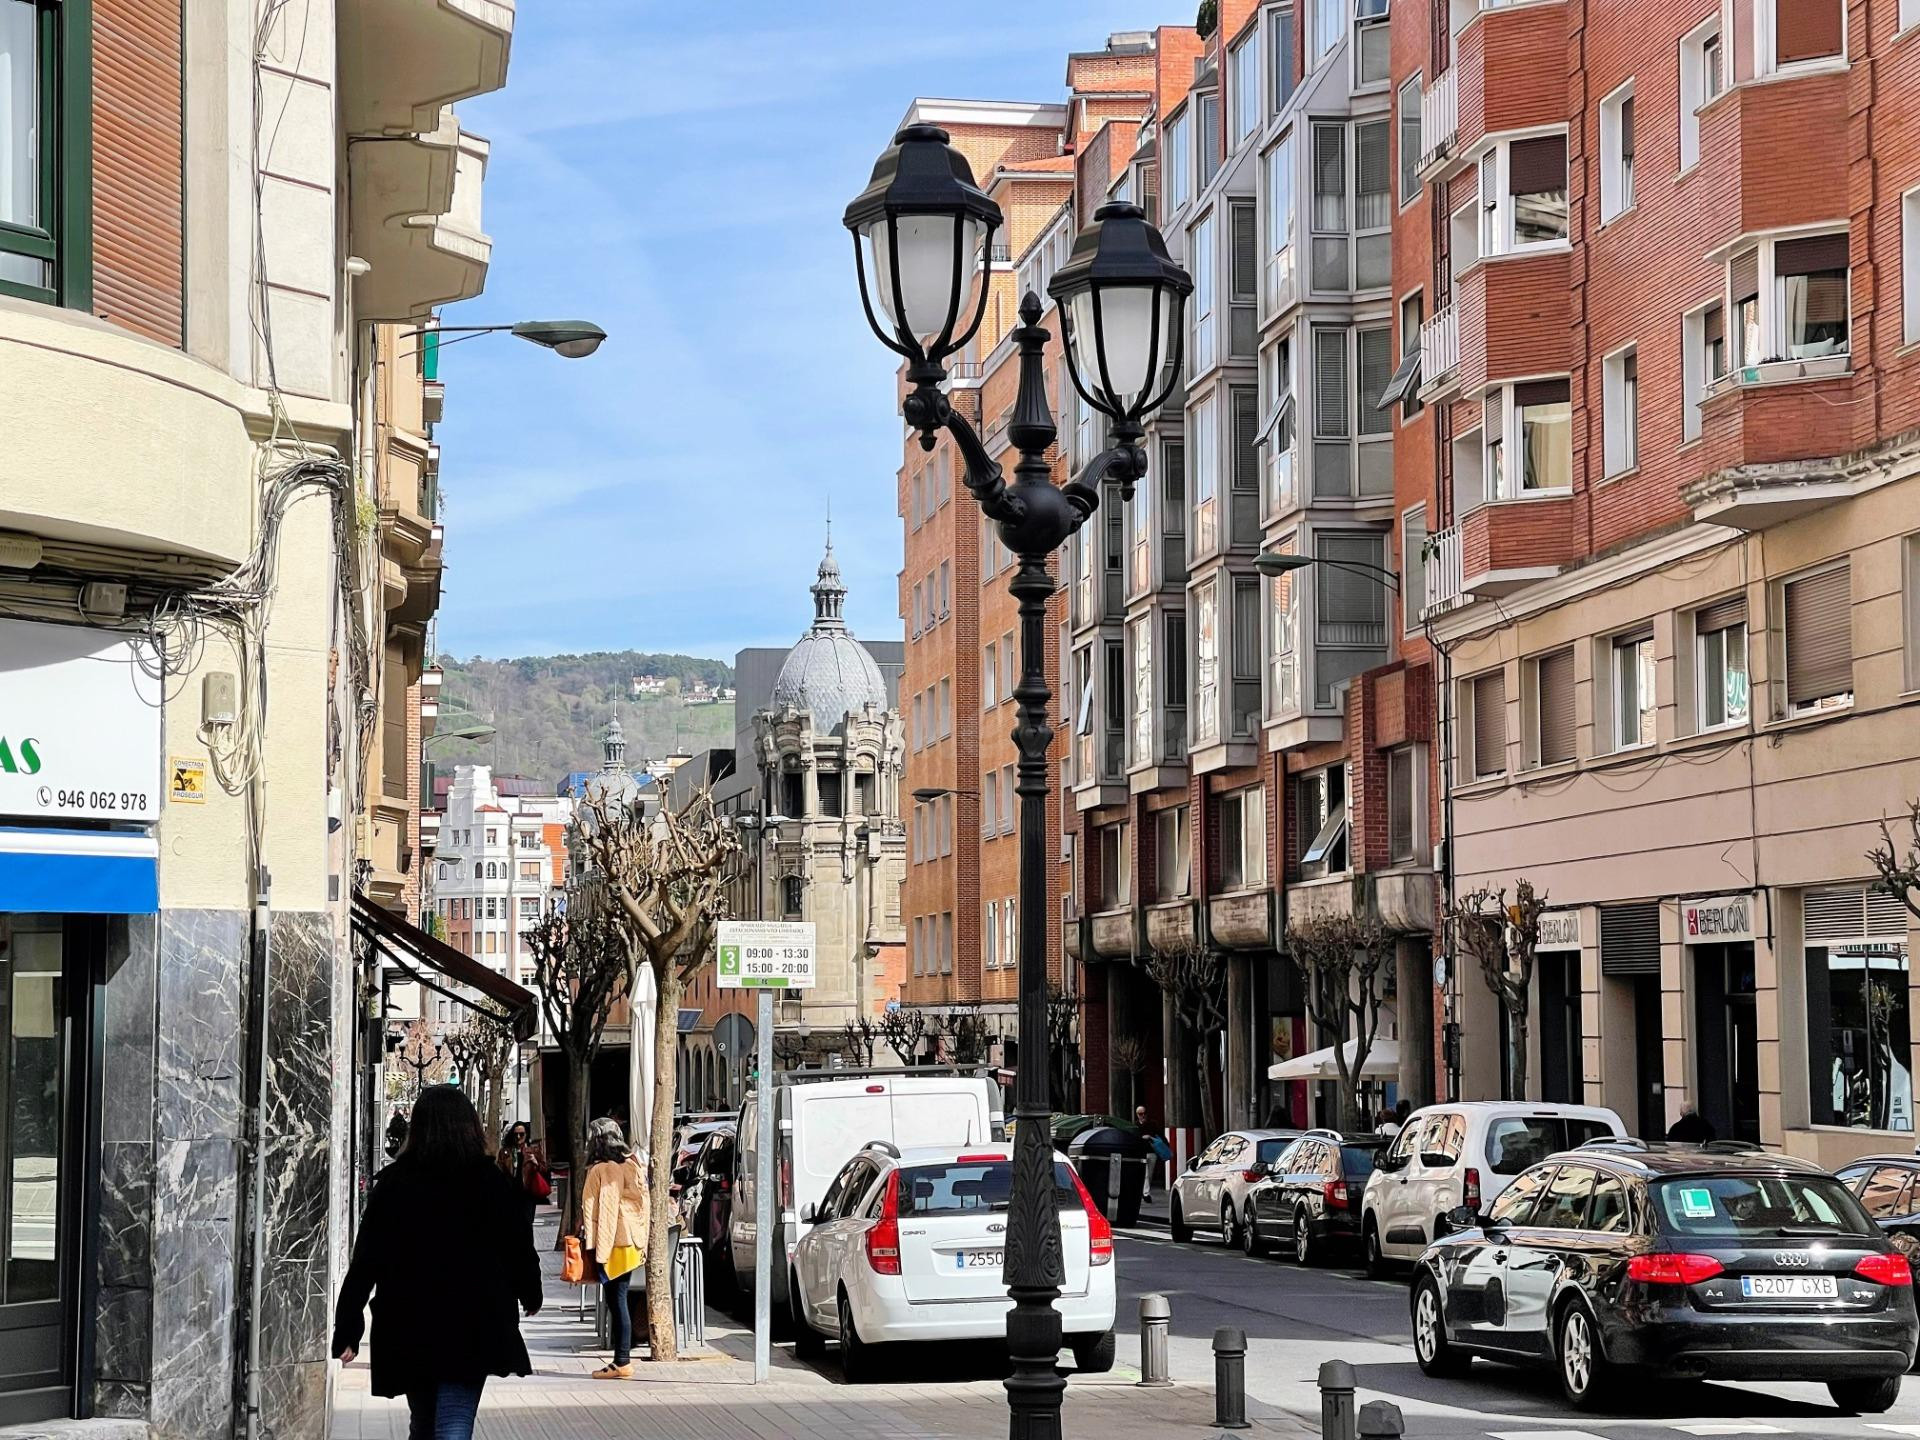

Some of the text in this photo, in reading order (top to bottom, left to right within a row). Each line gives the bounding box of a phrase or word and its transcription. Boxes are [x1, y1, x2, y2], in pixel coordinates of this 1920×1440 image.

[58, 790, 147, 811] 946 062 978
[173, 791, 203, 800] PROSEGUR
[1698, 903, 1750, 935] BERLONI
[1542, 918, 1578, 944] BERLONI
[725, 951, 736, 969] 3
[746, 948, 773, 959] 09:00
[783, 948, 809, 959] 13:30
[746, 963, 773, 973] 15:00
[782, 963, 809, 973] 20:00
[968, 1252, 1004, 1267] 2550
[1705, 1289, 1724, 1297] A4
[1754, 1278, 1794, 1295] 6207
[1801, 1278, 1833, 1295] GXB
